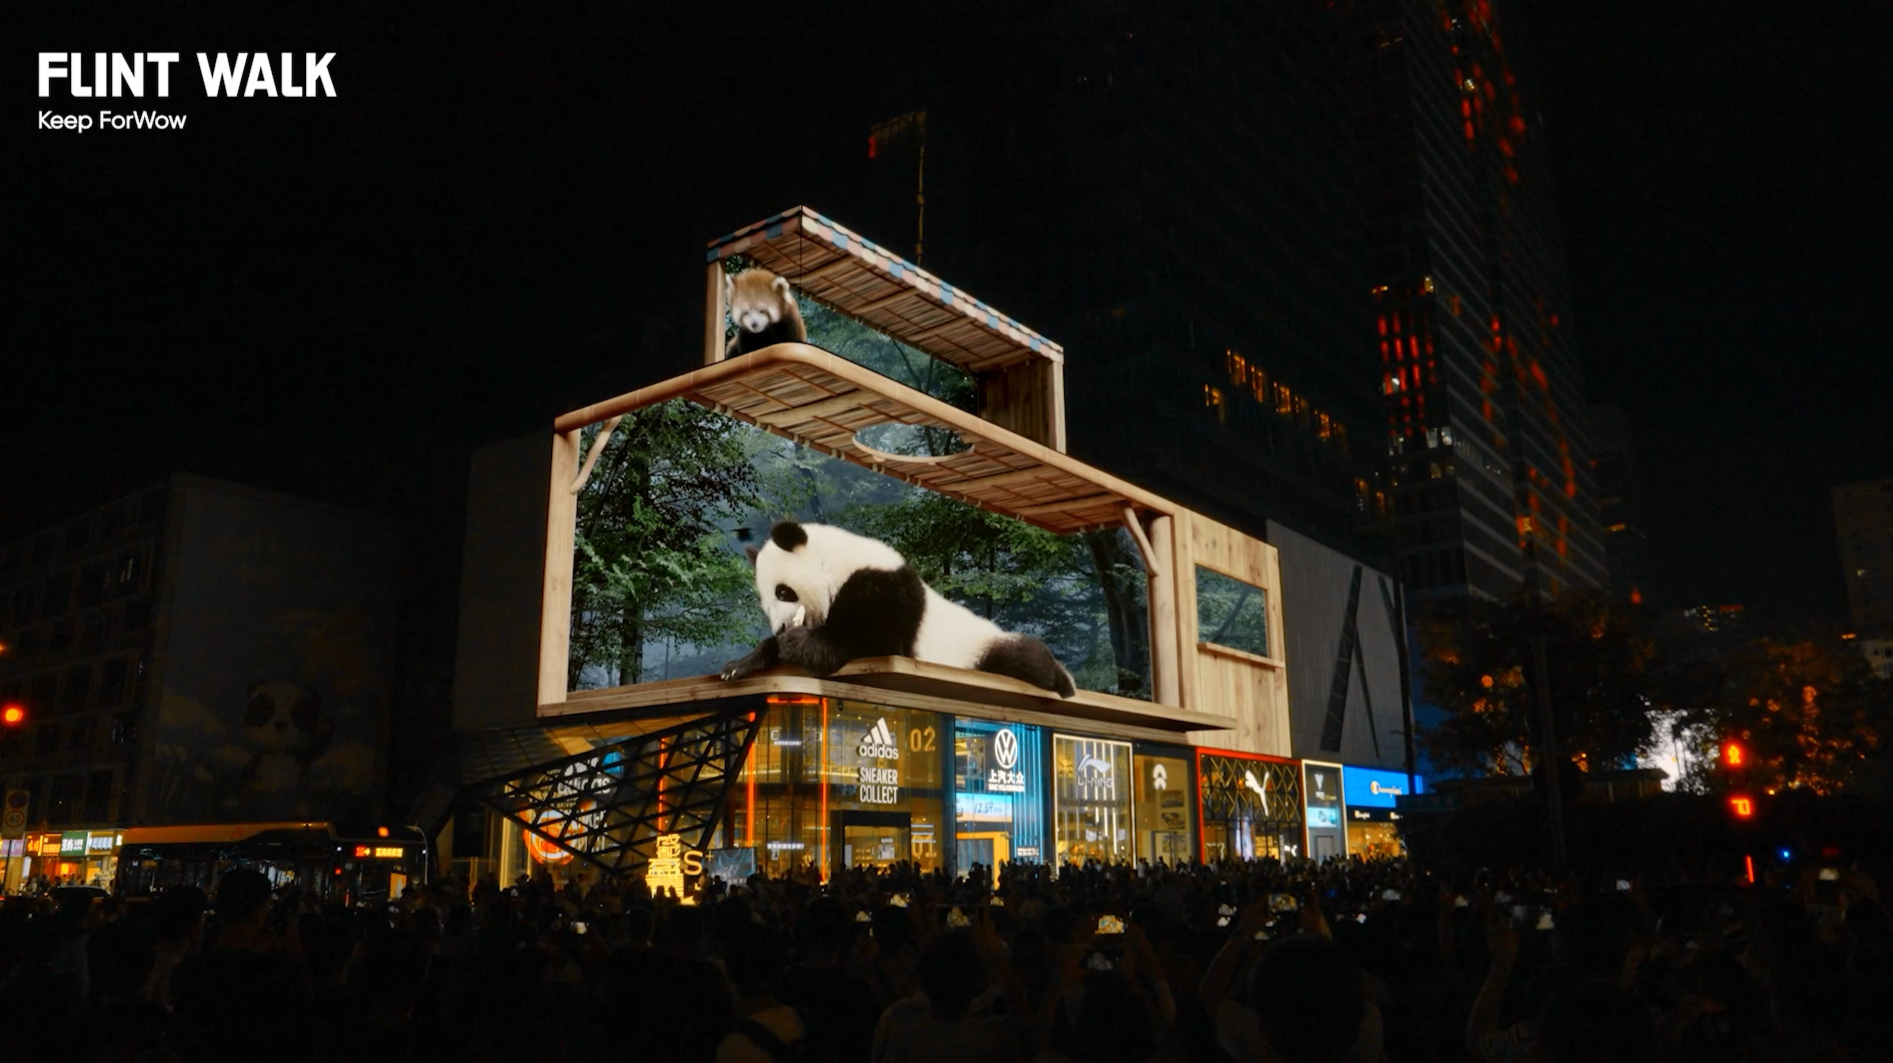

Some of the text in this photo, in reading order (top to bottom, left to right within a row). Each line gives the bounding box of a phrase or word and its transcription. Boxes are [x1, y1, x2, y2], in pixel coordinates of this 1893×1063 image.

[910, 727, 936, 752] 02
[859, 743, 899, 760] adidas
[859, 767, 898, 785] SNEAKER
[988, 769, 1025, 785] 上汽大众
[1077, 776, 1113, 788] LI-NING
[859, 784, 899, 804] COLLECT
[8, 814, 21, 824] 40
